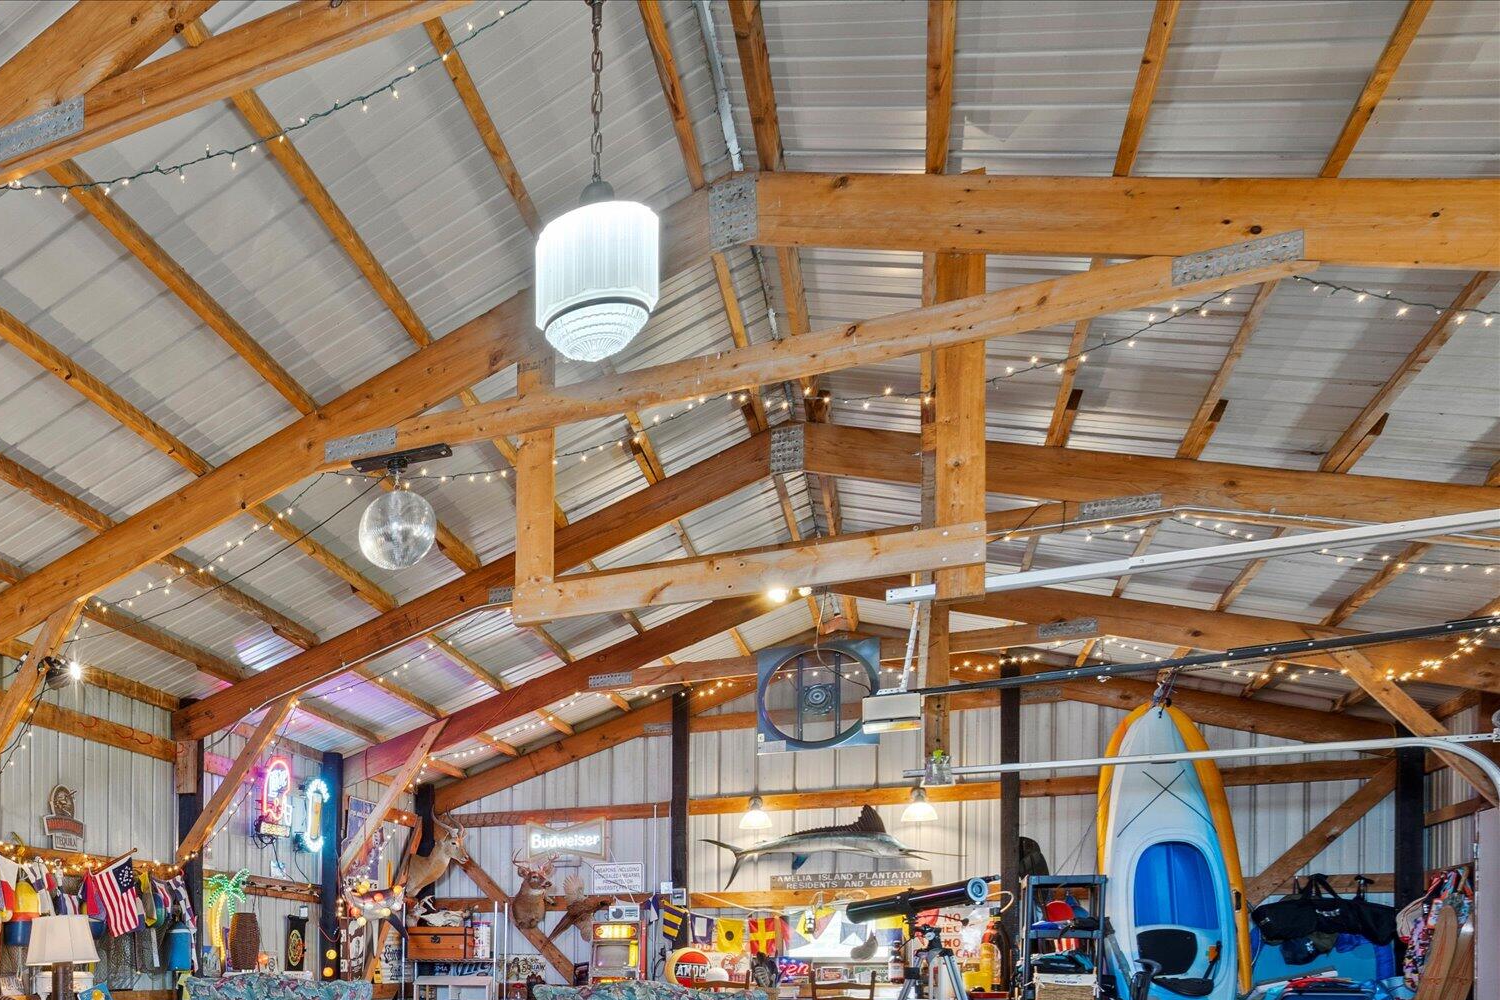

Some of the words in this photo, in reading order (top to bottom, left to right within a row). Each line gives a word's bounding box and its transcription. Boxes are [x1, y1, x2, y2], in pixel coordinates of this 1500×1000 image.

[531, 832, 600, 849] Budweiser
[777, 874, 812, 883] AMELIA
[818, 873, 853, 881] ISLAND
[859, 871, 922, 880] PLANTATION
[786, 881, 838, 890] RESIDENTS
[844, 880, 864, 888] AND
[870, 878, 911, 887] GUESTS
